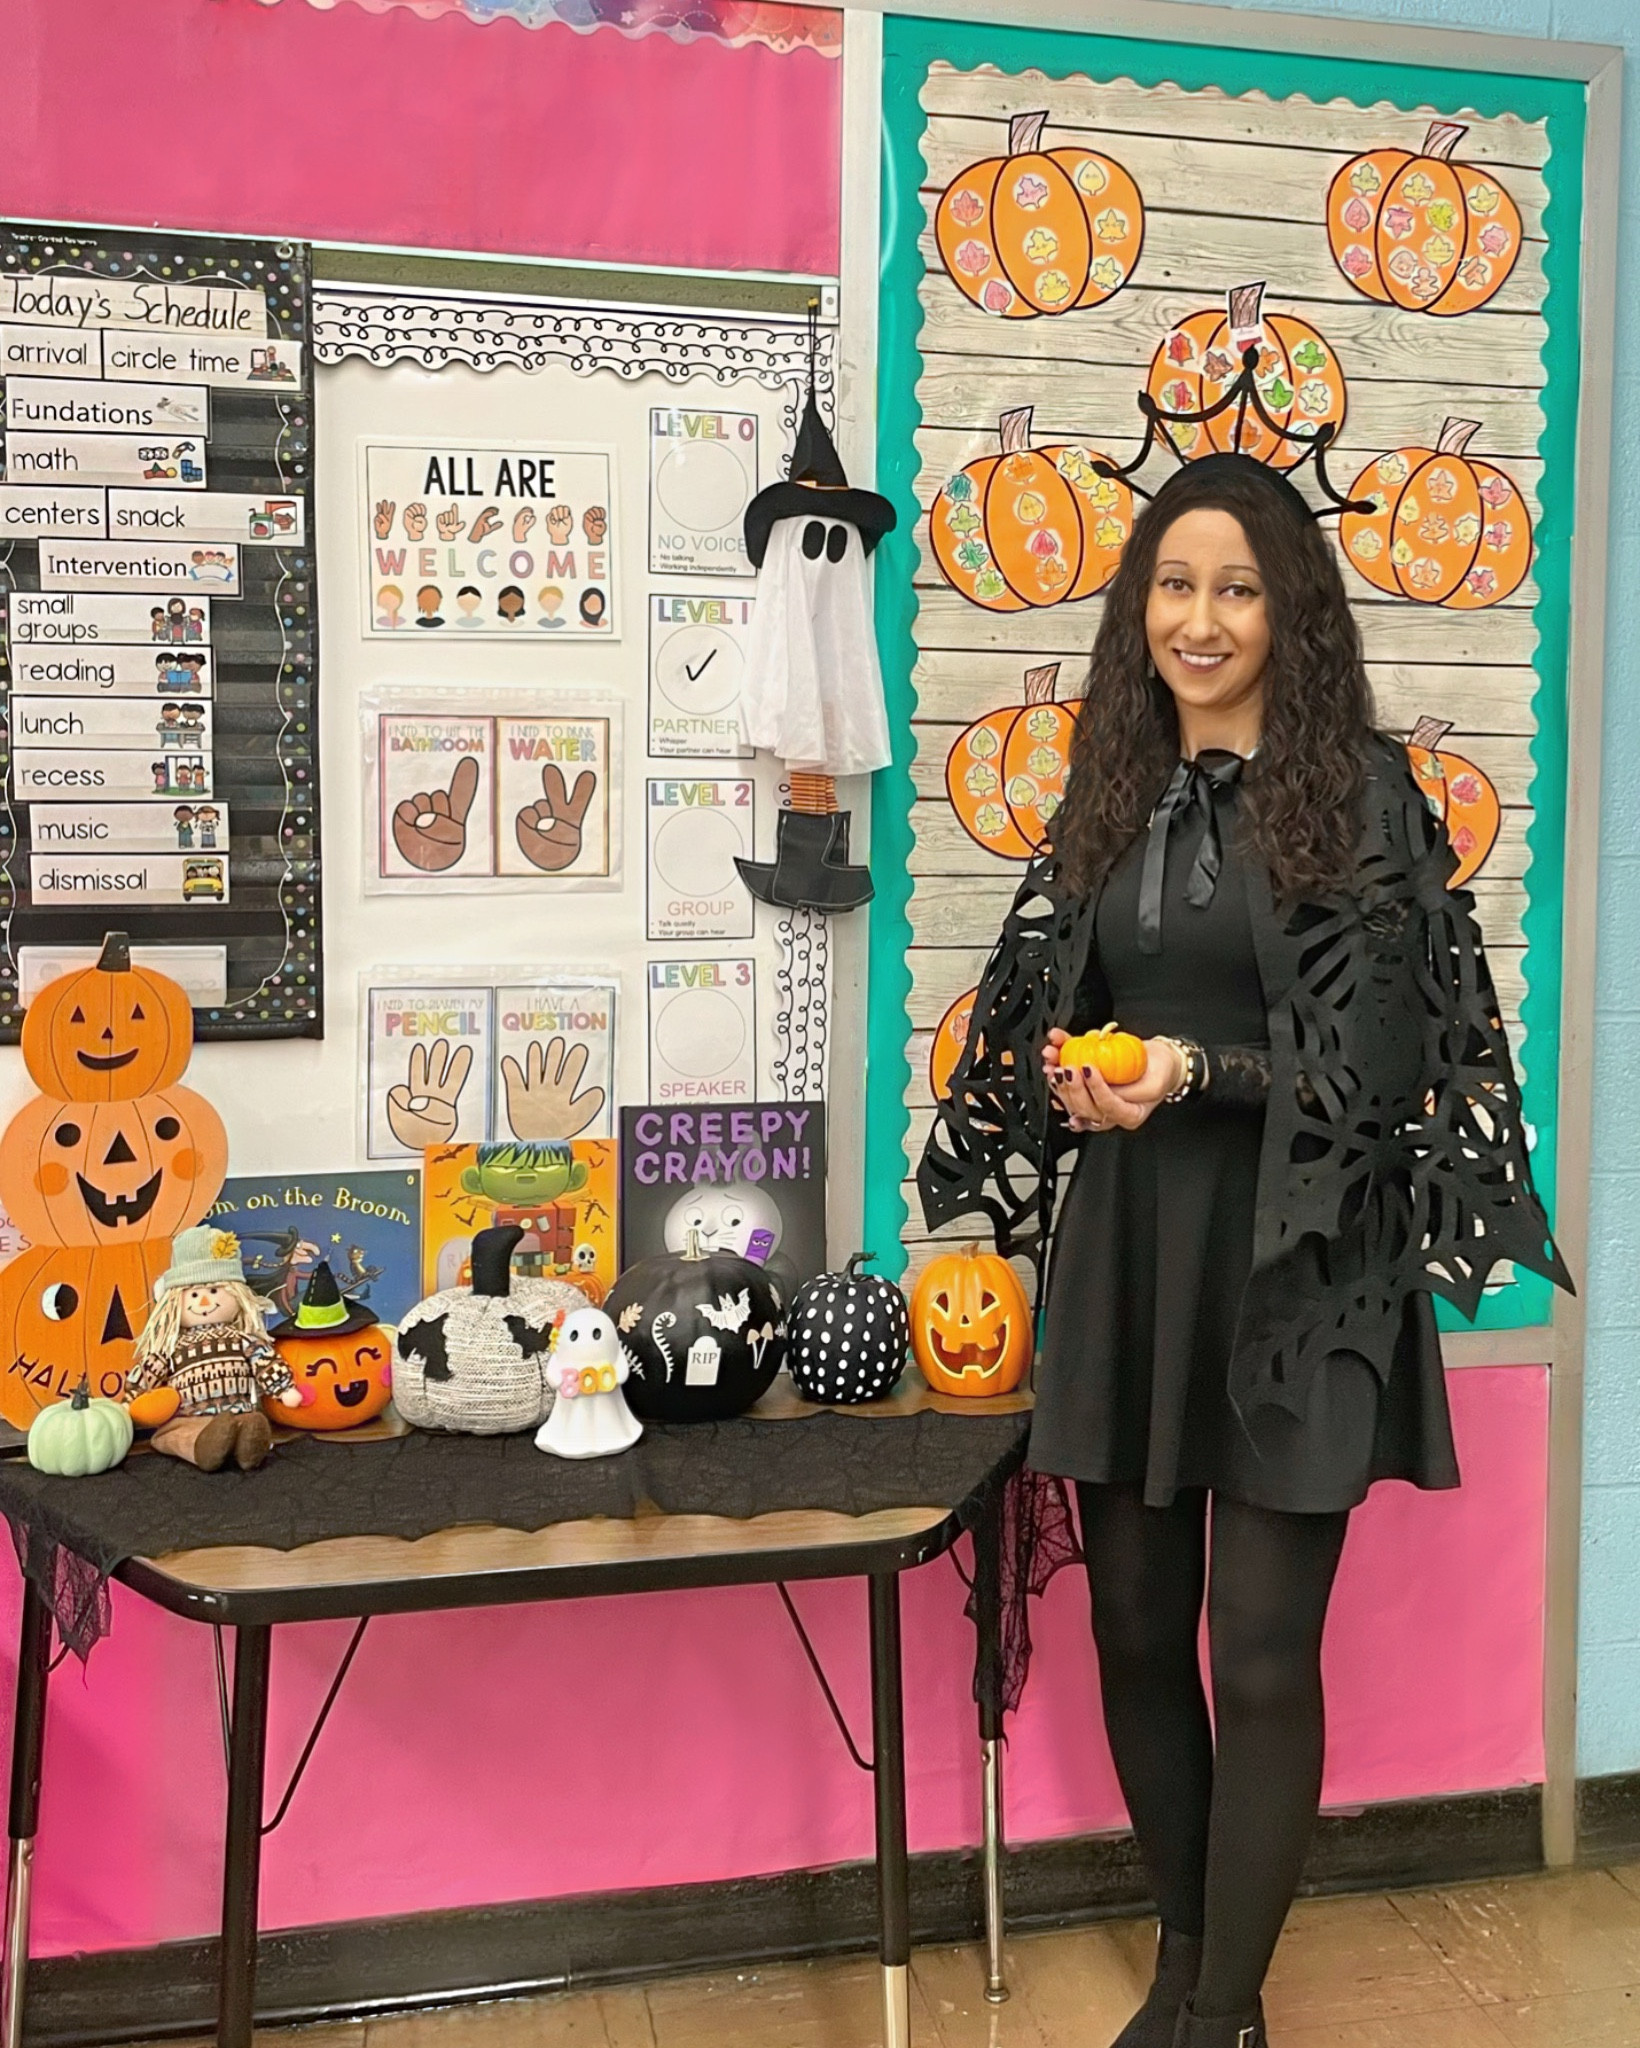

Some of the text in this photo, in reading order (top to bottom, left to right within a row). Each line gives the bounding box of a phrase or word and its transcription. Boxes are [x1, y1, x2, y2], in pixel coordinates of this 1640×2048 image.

[3, 275, 253, 331] Today's Schedule
[7, 341, 88, 365] arrival
[111, 346, 241, 373] circle time
[11, 398, 154, 426] Fundations
[654, 412, 729, 439] LEVEL
[12, 447, 79, 471] math
[424, 456, 556, 498] ALL ARE
[5, 502, 100, 526] centers
[116, 505, 186, 528] snack
[658, 534, 747, 553] NO VOICE
[48, 555, 188, 578] Intervention
[376, 548, 606, 580] WELCOME
[17, 595, 74, 615] small
[658, 598, 733, 624] LEVEL
[17, 619, 99, 644] groups
[19, 658, 115, 688] reading
[19, 711, 84, 735] lunch
[653, 718, 739, 735] PARTNER
[391, 737, 485, 752] BATHROOM
[508, 737, 597, 761] WATER
[21, 766, 105, 787] recess
[651, 782, 750, 806] LEVEL 2
[38, 817, 109, 840] music
[38, 868, 148, 891] dismissal
[667, 901, 734, 916] GROUP
[652, 963, 751, 988] LEVEL 3
[386, 1011, 481, 1036] PENCIL
[502, 1012, 606, 1031] QUESTION
[660, 1080, 747, 1098] SPEAKER
[635, 1110, 810, 1146] CREEPY
[634, 1147, 810, 1184] CRAYON!
[246, 1192, 279, 1210] on
[284, 1186, 323, 1207] the
[333, 1187, 410, 1226] Broom
[691, 1352, 718, 1364] RIP
[561, 1365, 616, 1398] BOO
